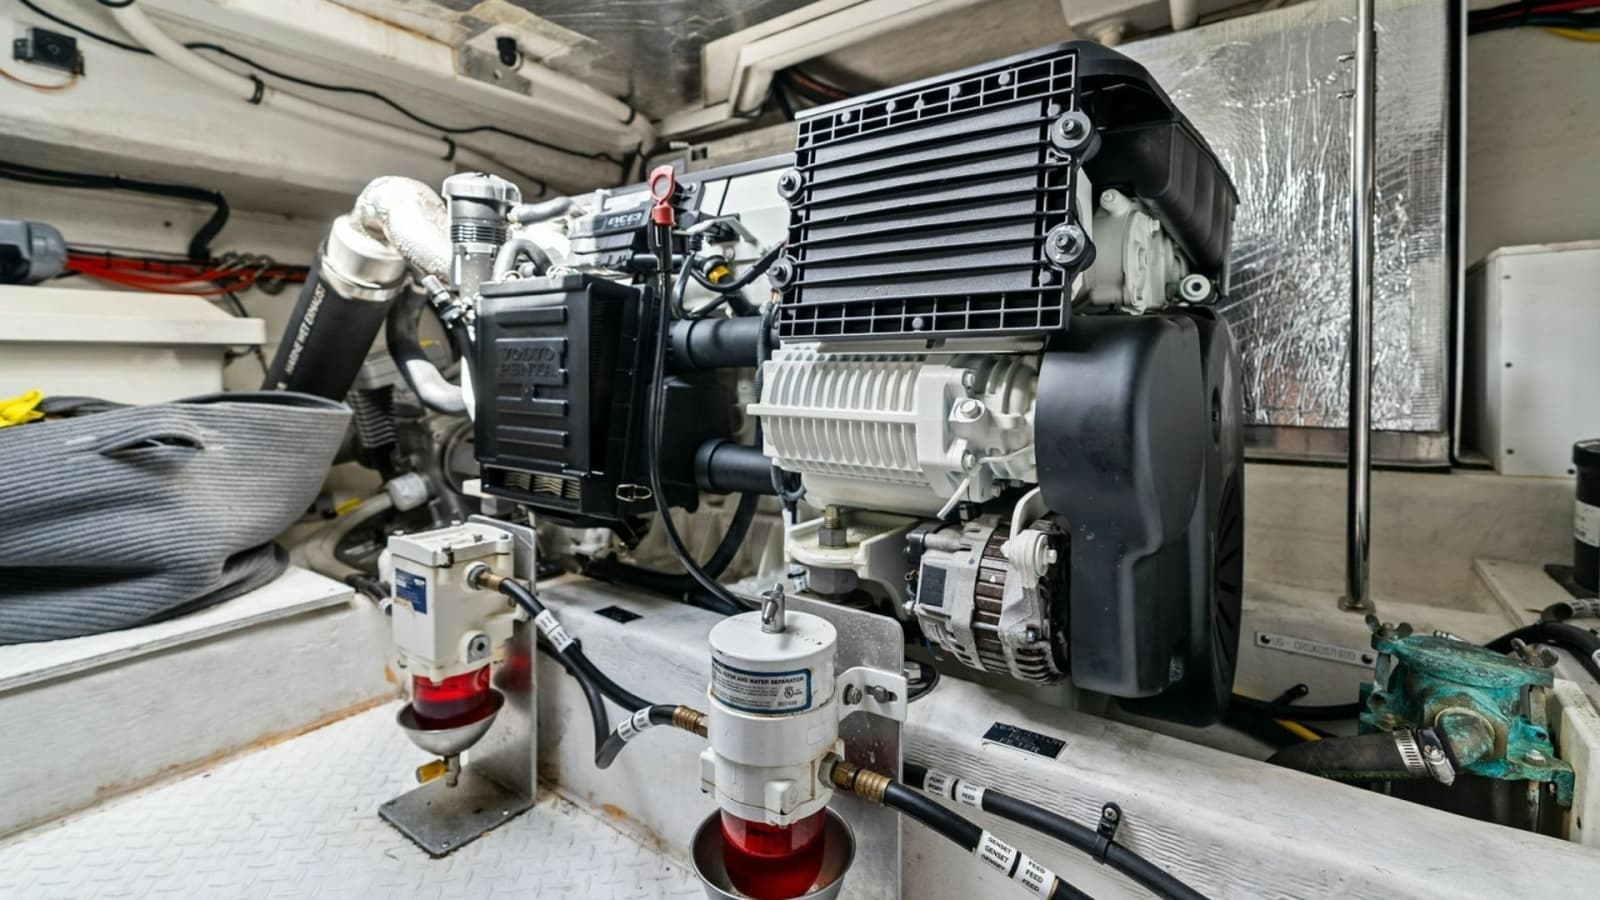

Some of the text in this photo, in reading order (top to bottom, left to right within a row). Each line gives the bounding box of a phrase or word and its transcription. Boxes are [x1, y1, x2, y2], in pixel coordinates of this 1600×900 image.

[297, 321, 310, 343] WET
[304, 283, 326, 325] EXHAUST
[502, 347, 555, 362] VOLVO
[750, 677, 770, 685] WATER
[771, 676, 804, 685] SEPARATOR
[962, 792, 976, 801] FEED
[988, 836, 1012, 854] GENSET
[984, 845, 1009, 864] GENSET
[1028, 860, 1046, 874] FEED
[1025, 869, 1044, 884] FEED
[1021, 878, 1040, 892] FEED
